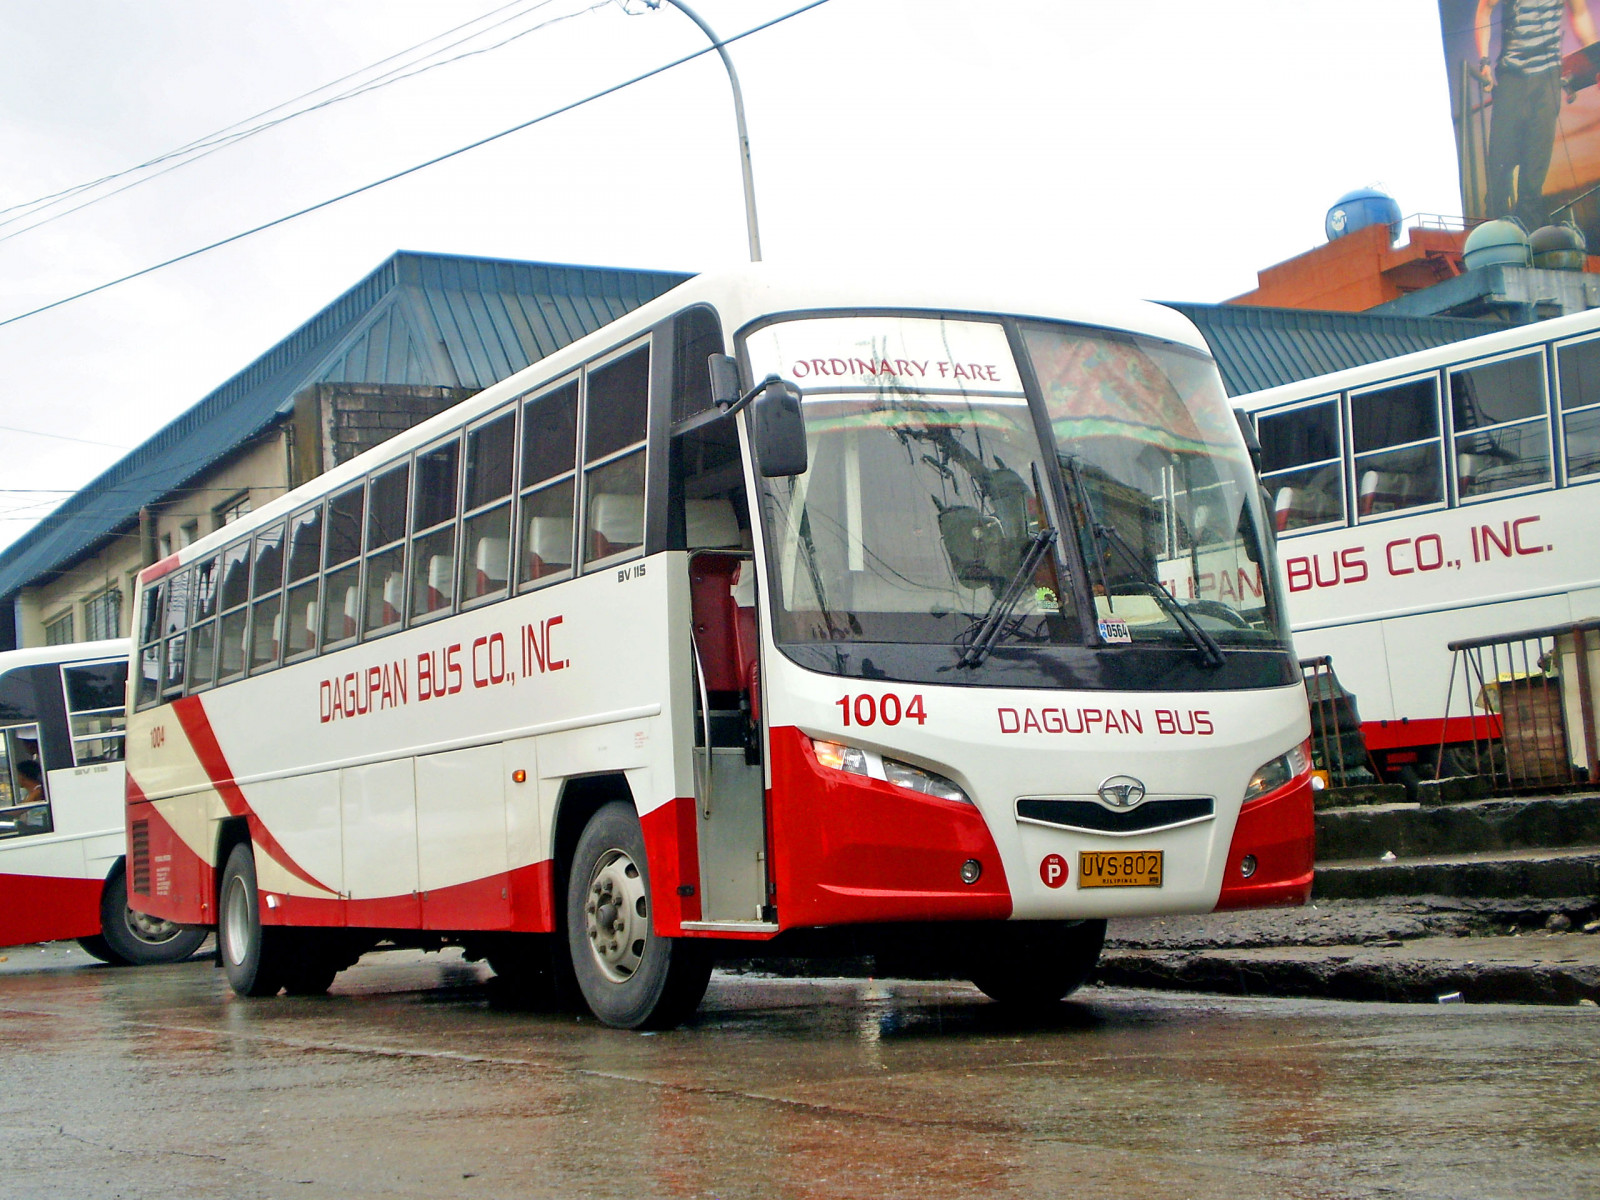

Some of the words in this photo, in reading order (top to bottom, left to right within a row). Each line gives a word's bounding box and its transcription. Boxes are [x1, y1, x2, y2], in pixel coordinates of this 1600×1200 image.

[792, 357, 930, 379] ORDINARY
[936, 361, 1002, 382] FARE
[1160, 562, 1264, 603] UPAN
[1286, 545, 1369, 593] BUS
[1386, 532, 1462, 577] CO.,
[1471, 514, 1554, 564] INC.
[617, 567, 631, 583] BV
[1106, 623, 1129, 638] 0564
[319, 657, 408, 724] DAGUPAN
[417, 643, 463, 702] BUS
[472, 631, 515, 687] CO.,
[521, 614, 571, 679] INC.
[835, 693, 927, 727] 1004
[997, 707, 1144, 734] DAGUPAN
[1154, 709, 1214, 735] BUS
[150, 724, 165, 749] 1004
[1048, 864, 1061, 884] P
